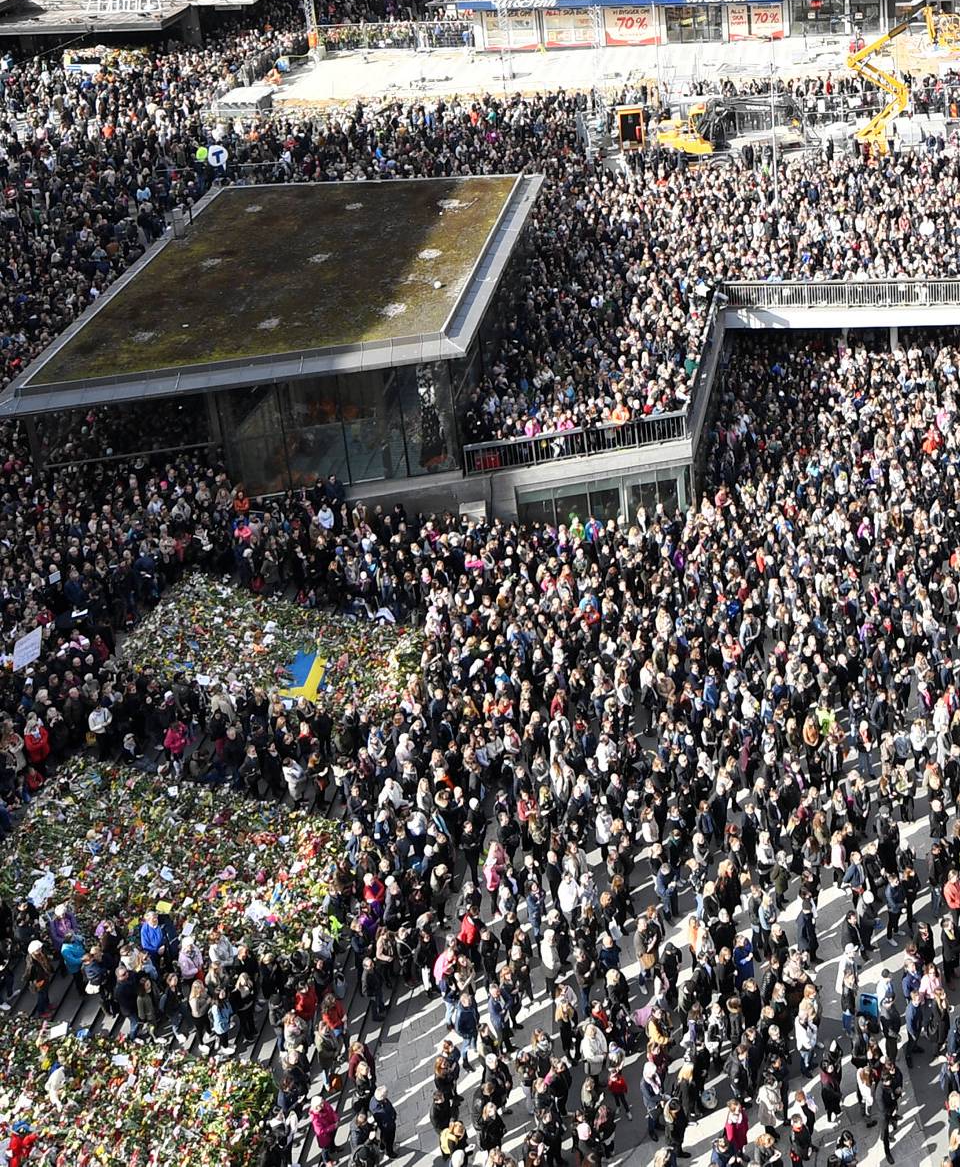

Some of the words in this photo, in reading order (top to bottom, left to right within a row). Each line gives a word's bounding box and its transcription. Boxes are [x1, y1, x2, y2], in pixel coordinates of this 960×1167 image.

[617, 17, 648, 31] 70%
[754, 13, 780, 24] 70%
[212, 149, 224, 164] T
